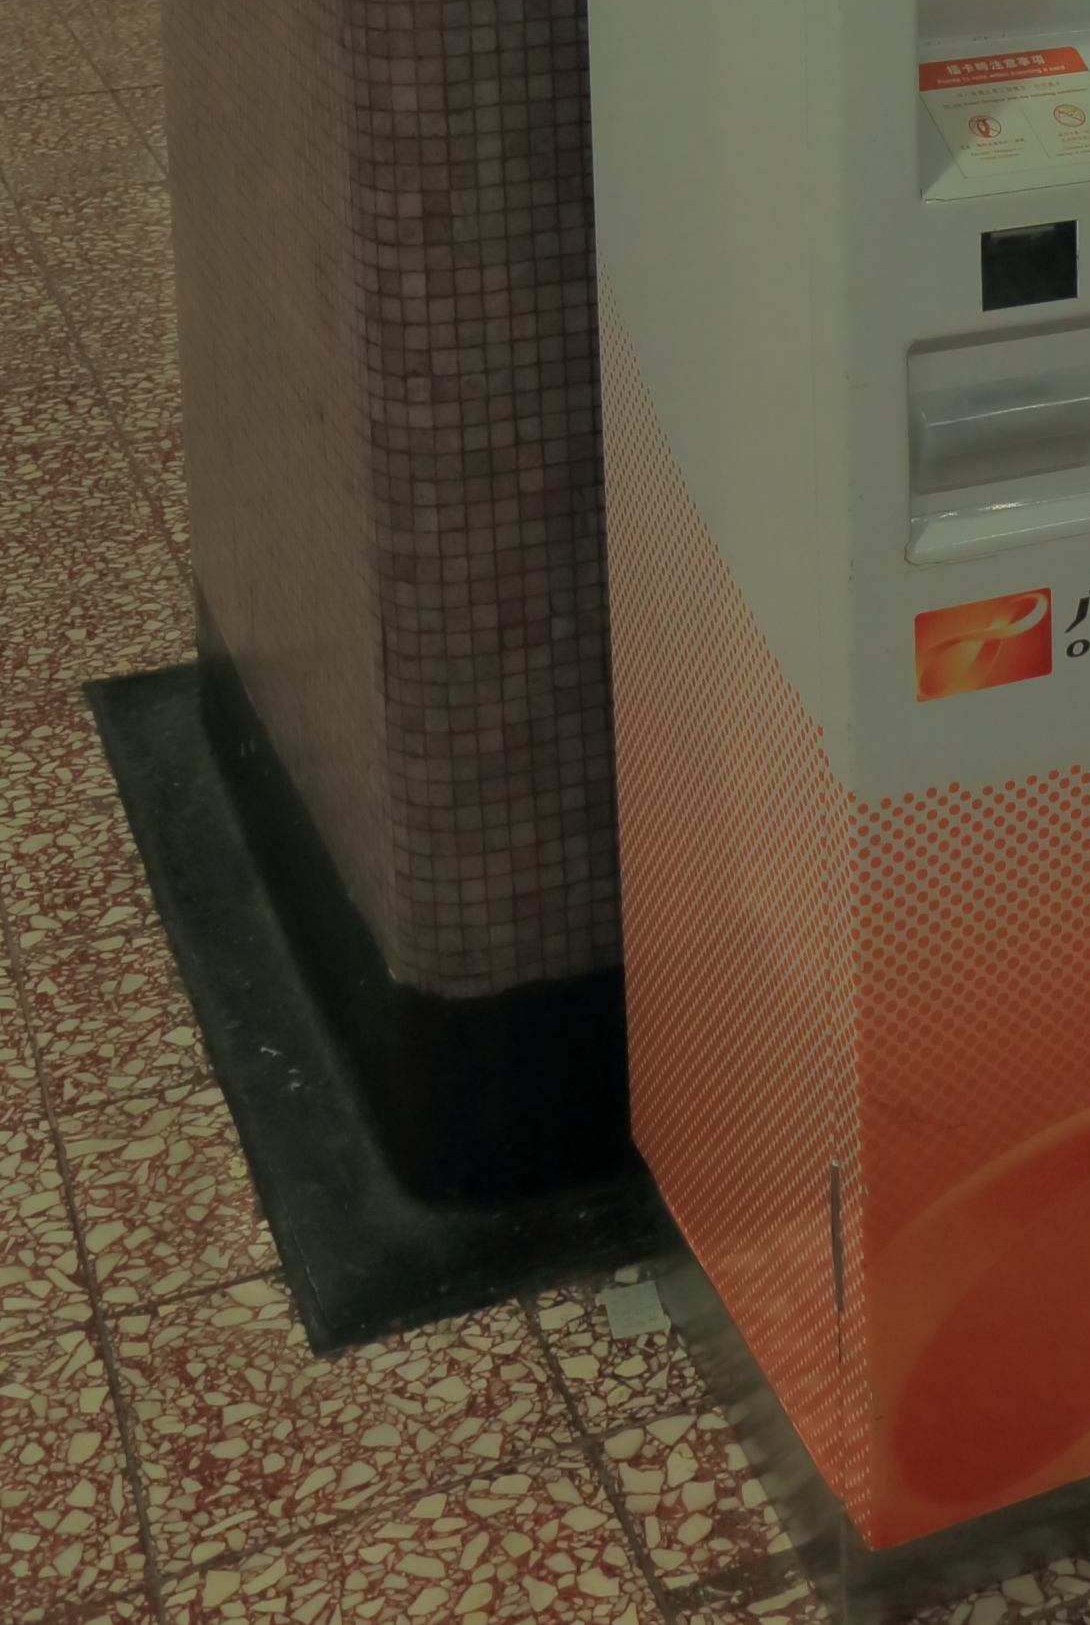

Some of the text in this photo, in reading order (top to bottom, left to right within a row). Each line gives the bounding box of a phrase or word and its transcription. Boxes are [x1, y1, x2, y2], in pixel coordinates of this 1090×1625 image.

[937, 77, 962, 85] Points
[972, 74, 989, 82] note
[1010, 67, 1043, 77] inserting
[1049, 65, 1066, 73] card
